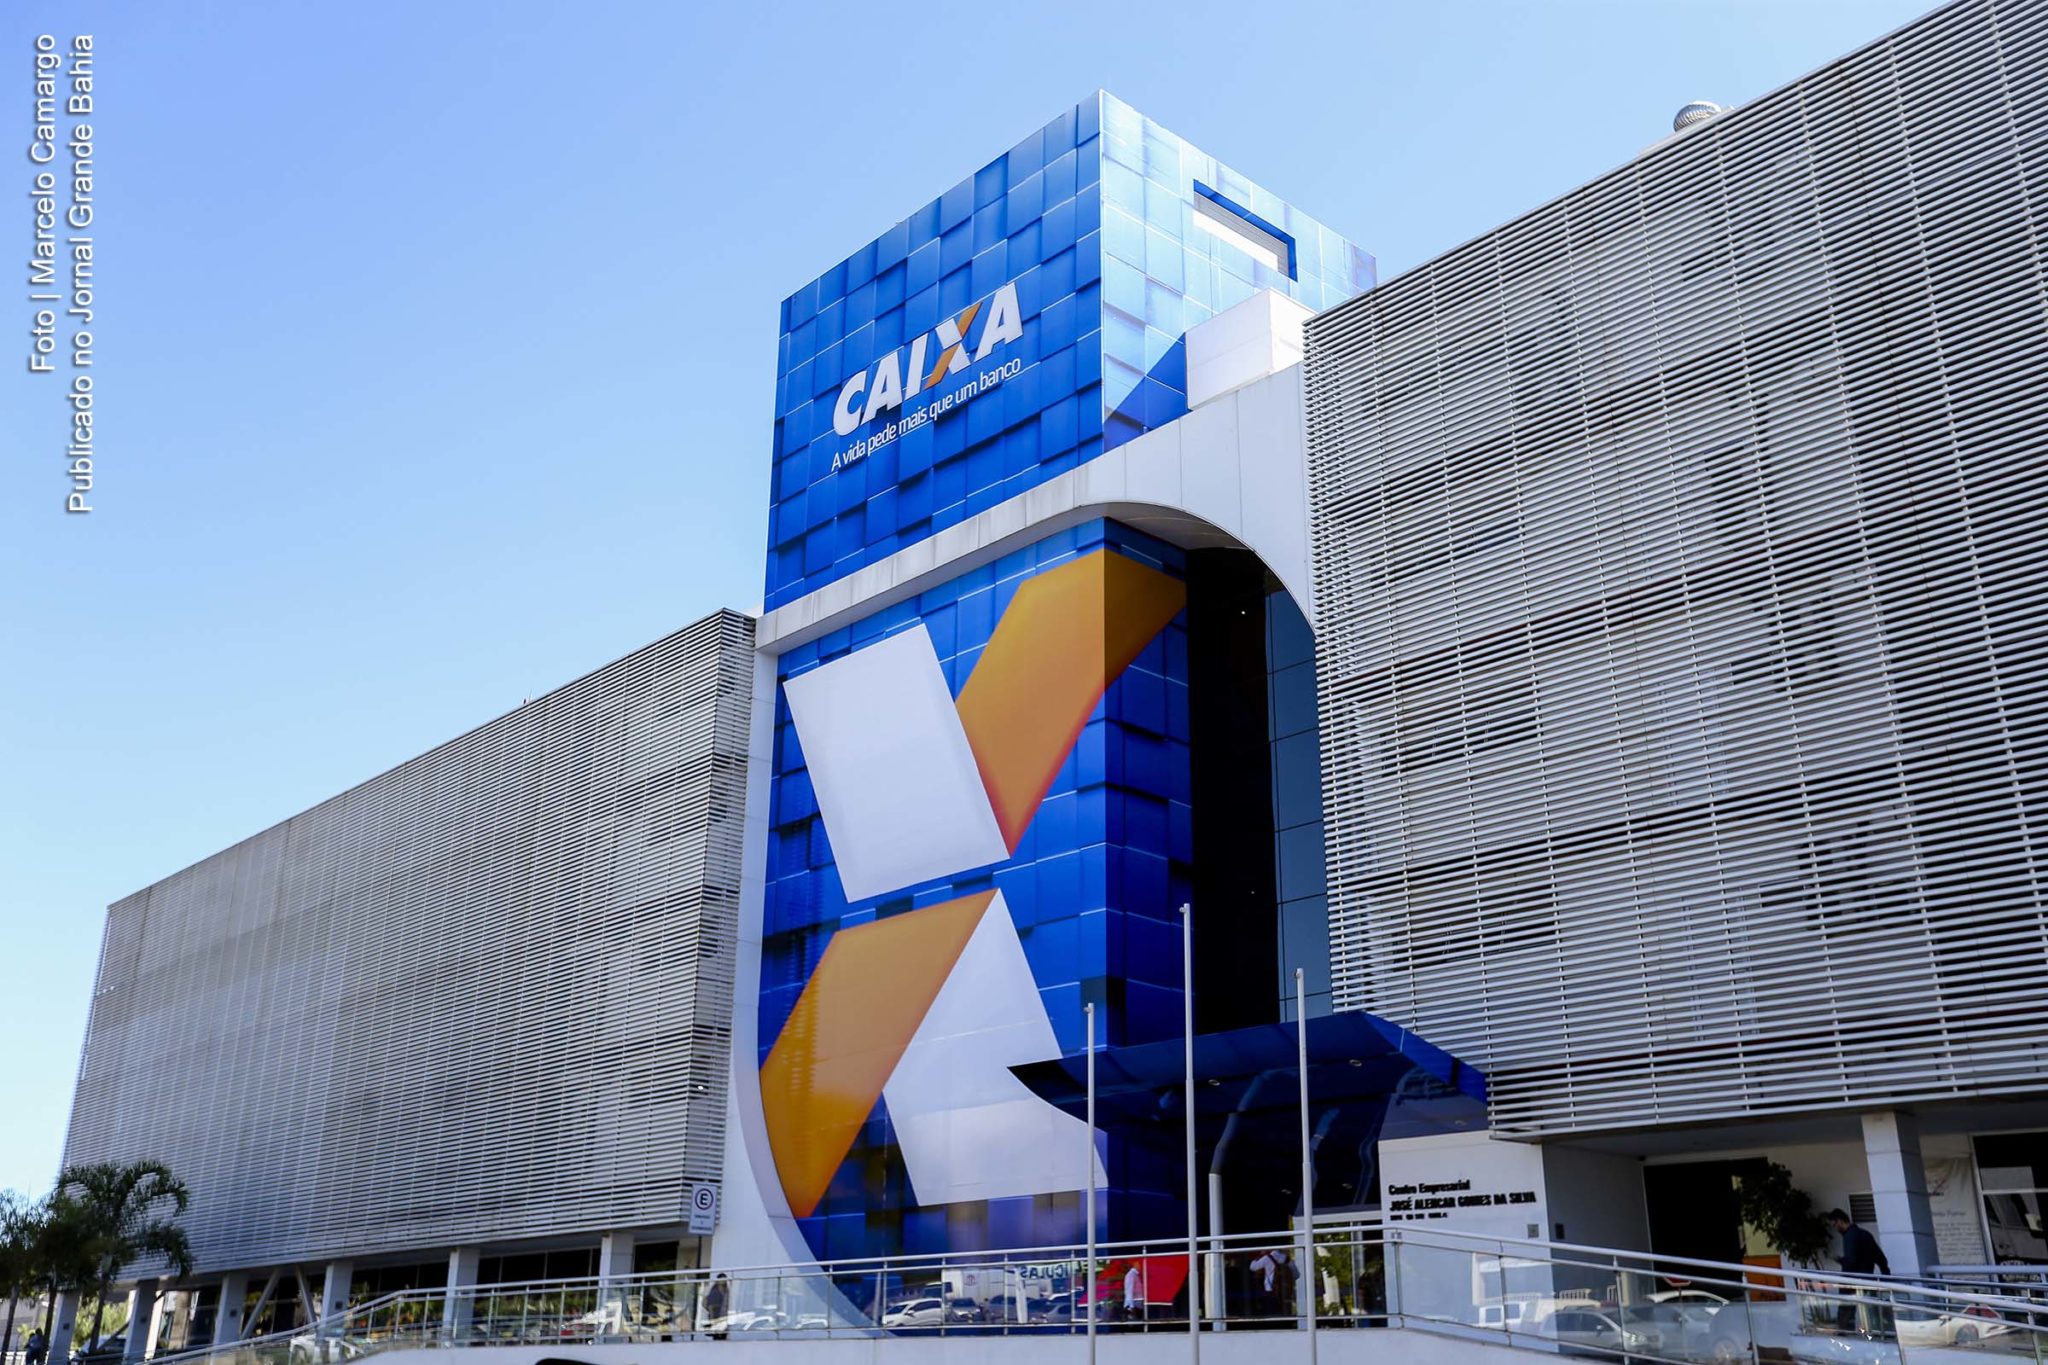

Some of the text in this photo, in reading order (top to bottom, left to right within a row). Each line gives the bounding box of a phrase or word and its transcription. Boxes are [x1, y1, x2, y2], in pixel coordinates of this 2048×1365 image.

[833, 281, 1023, 436] CAIXA
[831, 357, 1021, 472] A vida pede mais que um banco
[1389, 1180, 1470, 1195] Centro Empresarial
[1390, 1197, 1412, 1211] JOSÉ
[1415, 1198, 1455, 1210] ALENCAR
[1494, 1194, 1506, 1204] DA
[1509, 1192, 1536, 1203] SILVA
